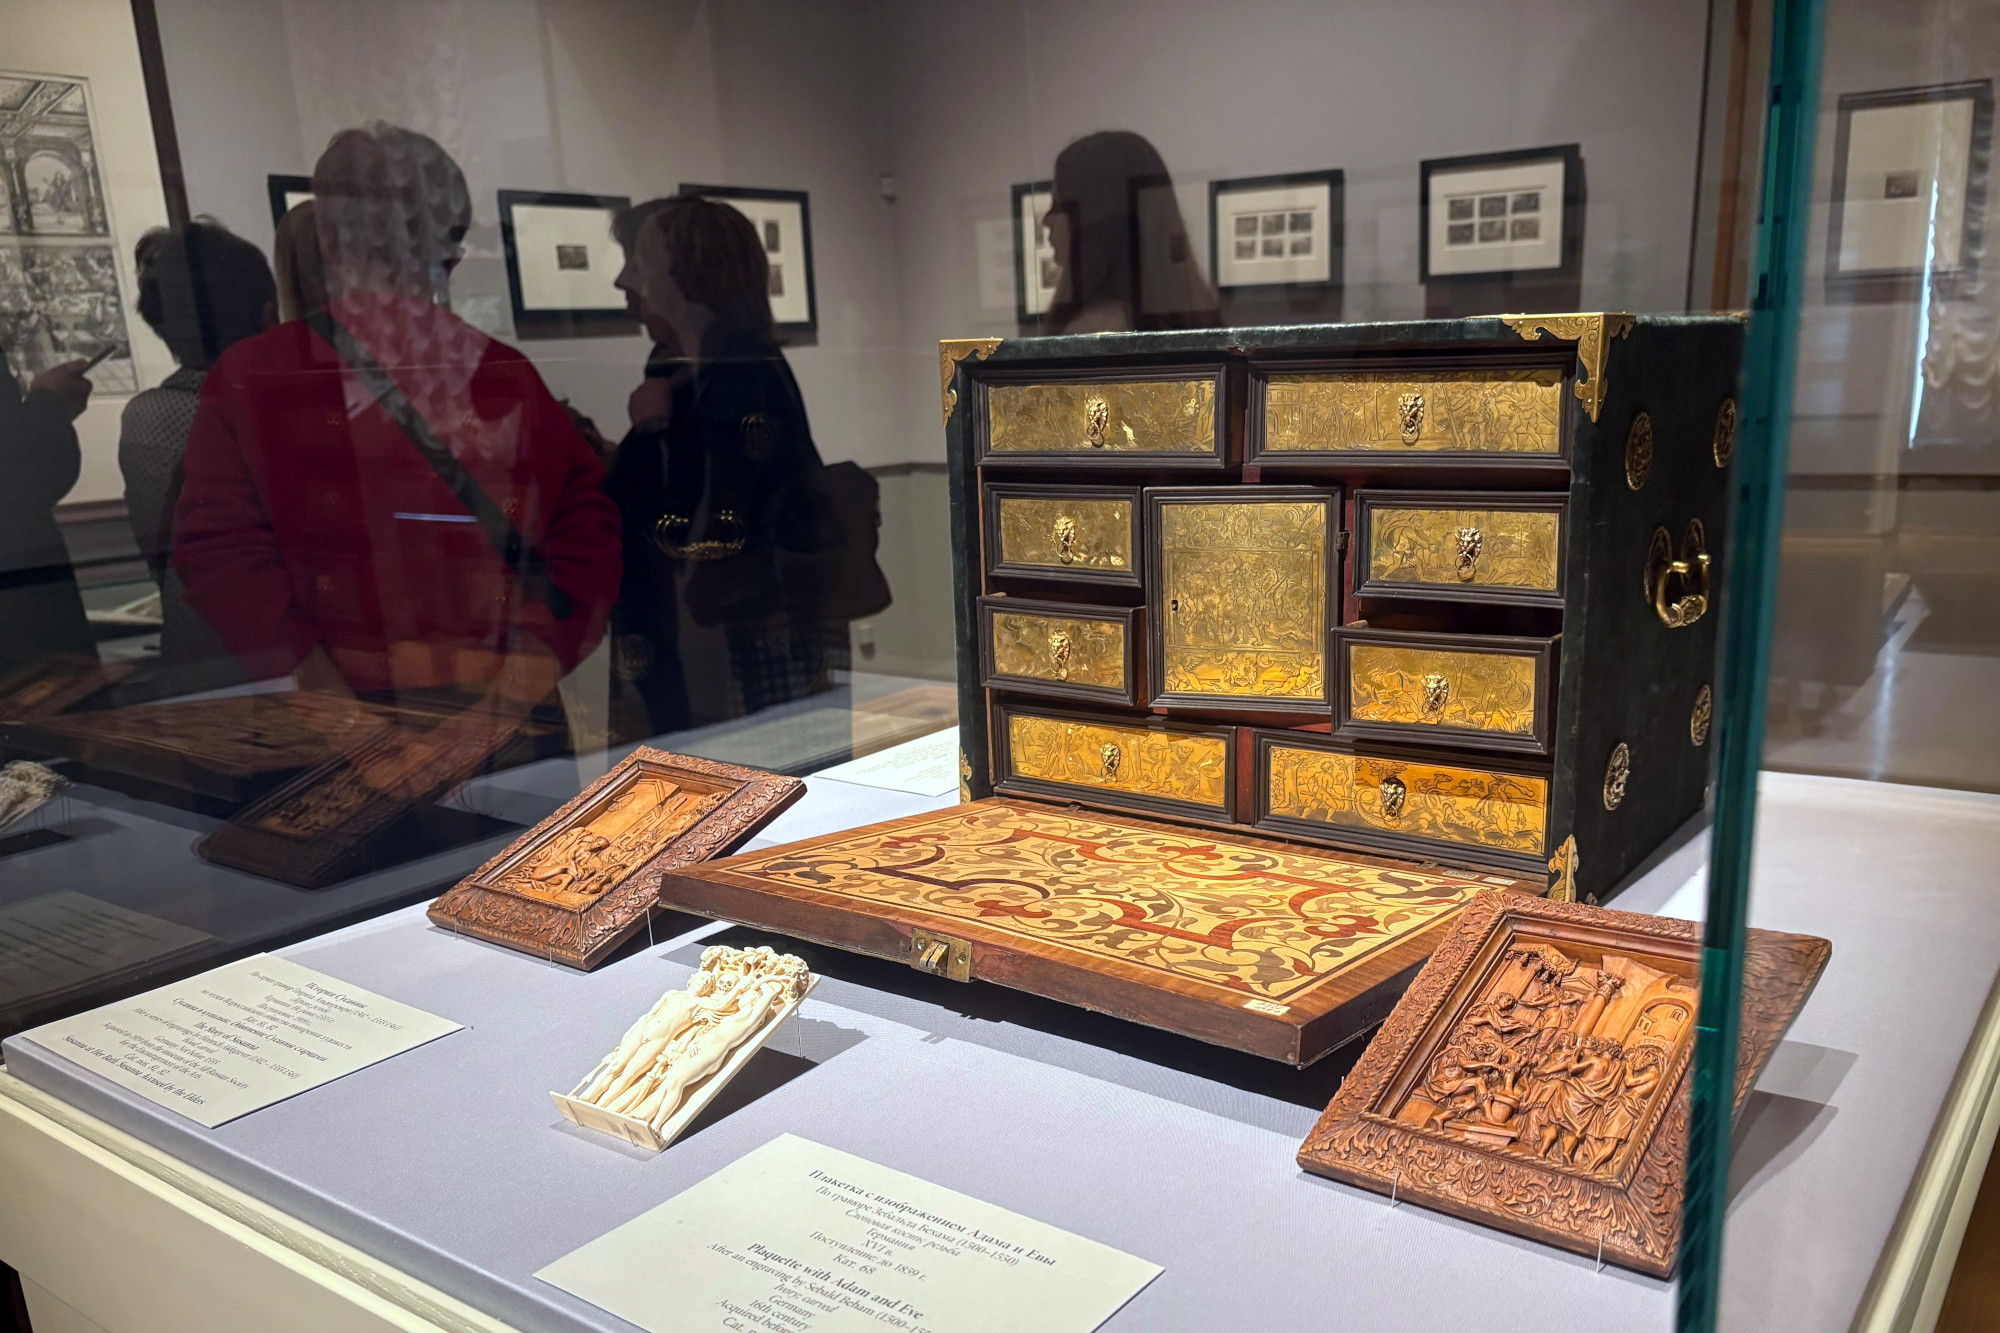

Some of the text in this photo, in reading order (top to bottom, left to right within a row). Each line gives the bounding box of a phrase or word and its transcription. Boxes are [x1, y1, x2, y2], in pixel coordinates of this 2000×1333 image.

[809, 1170, 864, 1194] Плакетка
[874, 1196, 965, 1232] изображением
[967, 1229, 1011, 1249] Адама
[1026, 1249, 1056, 1265] Евы
[831, 1193, 872, 1210] гравюре
[871, 1207, 917, 1228] Зебальда
[918, 1224, 955, 1242] Бехама
[845, 1209, 891, 1230] Слоновая
[922, 1241, 960, 1256] резьба
[861, 1239, 886, 1252] XVI
[866, 1228, 915, 1250] Германия
[832, 1253, 856, 1268] Кат.
[707, 1243, 733, 1255] After
[745, 1259, 792, 1282] engraving
[805, 1282, 841, 1300] Sebald
[839, 1296, 874, 1315] Beham
[747, 1243, 923, 1319] Plaquette with Adam and Eve
[716, 1300, 795, 1333] Acquired befor
[749, 1299, 812, 1332] 16th century
[767, 1295, 815, 1319] Germany
[802, 1297, 839, 1312] carved
[722, 1317, 744, 1332] Cat.
